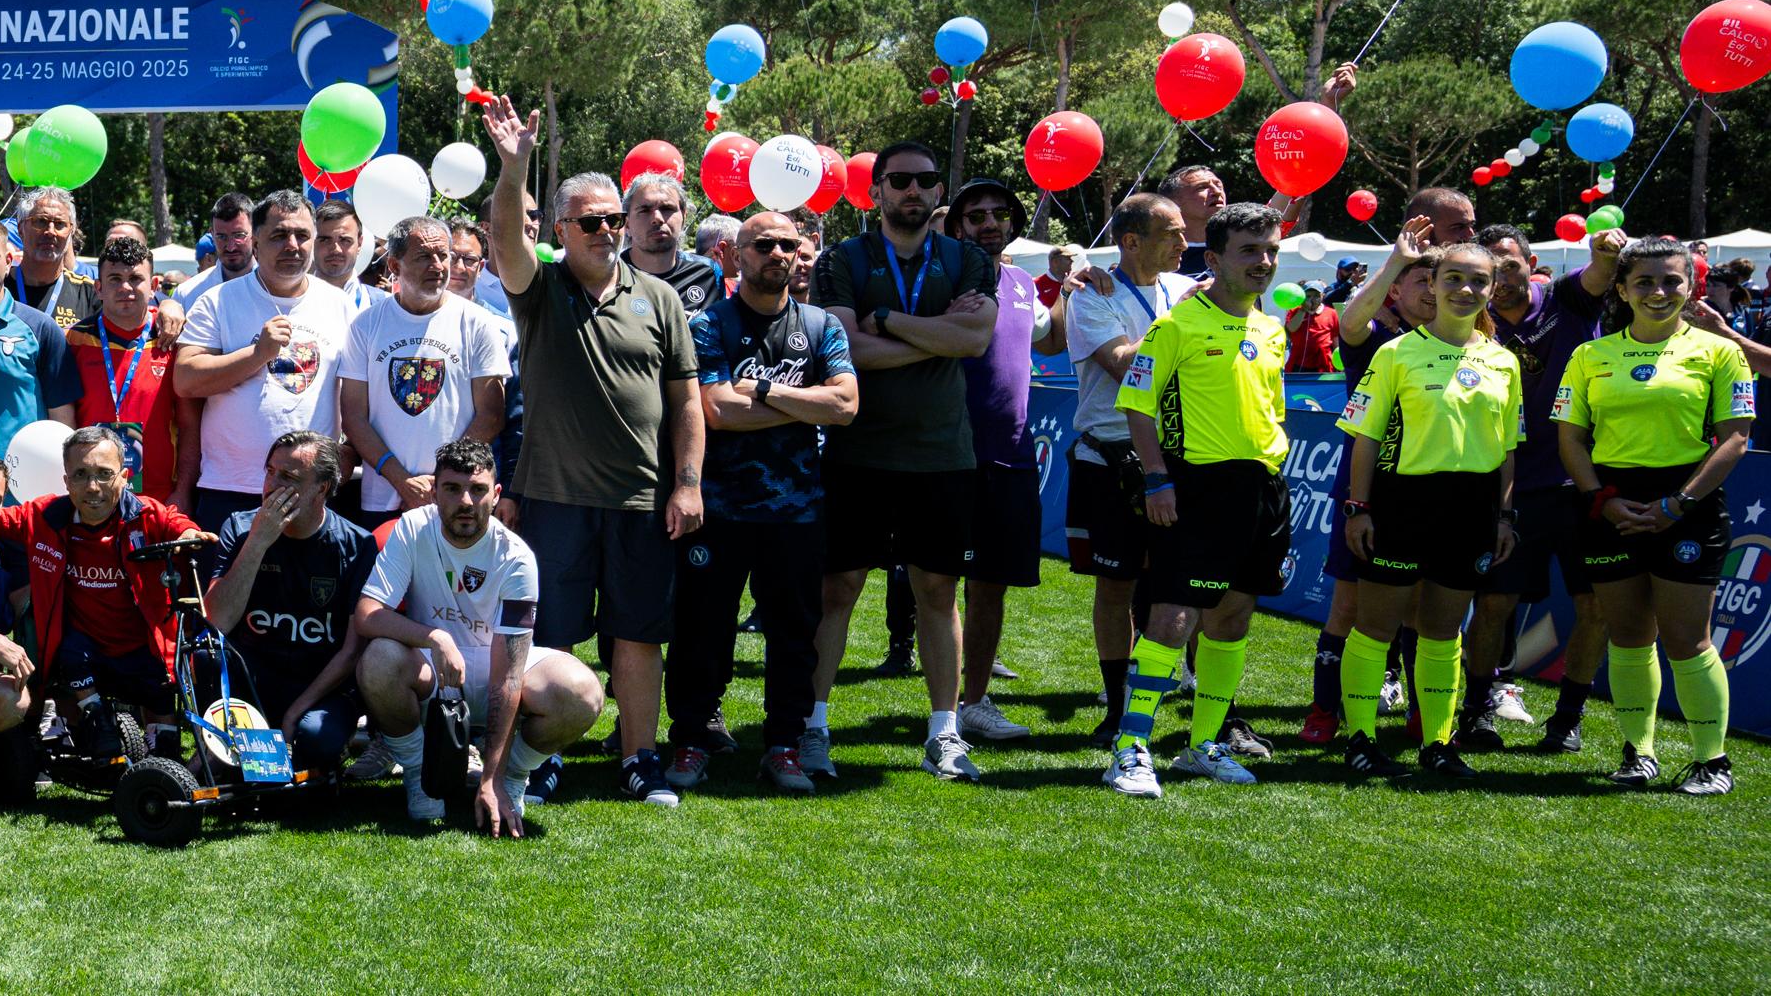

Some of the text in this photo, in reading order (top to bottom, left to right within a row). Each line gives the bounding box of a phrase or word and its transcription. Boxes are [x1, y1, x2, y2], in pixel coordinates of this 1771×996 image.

[0, 7, 189, 43] NAZIONALE
[1719, 27, 1767, 50] CALCIO
[1724, 49, 1753, 68] TUTTI
[2, 61, 55, 81] 24-25
[62, 60, 135, 79] MAGGIO
[142, 59, 189, 78] 2025
[1265, 130, 1304, 140] CALCIO
[1274, 151, 1305, 160] TUTTI
[785, 162, 810, 178] TUTTI
[57, 306, 76, 317] U.S.
[376, 337, 461, 364] WE ARE SUPERGA 48
[1439, 354, 1485, 363] GIVOVA
[1556, 388, 1572, 397] ET
[1733, 382, 1753, 393] NE
[1349, 392, 1372, 404] ET
[261, 564, 281, 572] oma
[1373, 557, 1418, 570] GIVOVA
[78, 580, 117, 588] Mediawan
[1190, 579, 1230, 589] GIVOVA
[1716, 580, 1762, 615] FIGC
[246, 610, 335, 643] enel
[70, 676, 94, 687] OVA
[1130, 693, 1152, 702] OVA
[1197, 692, 1231, 703] GIVOV
